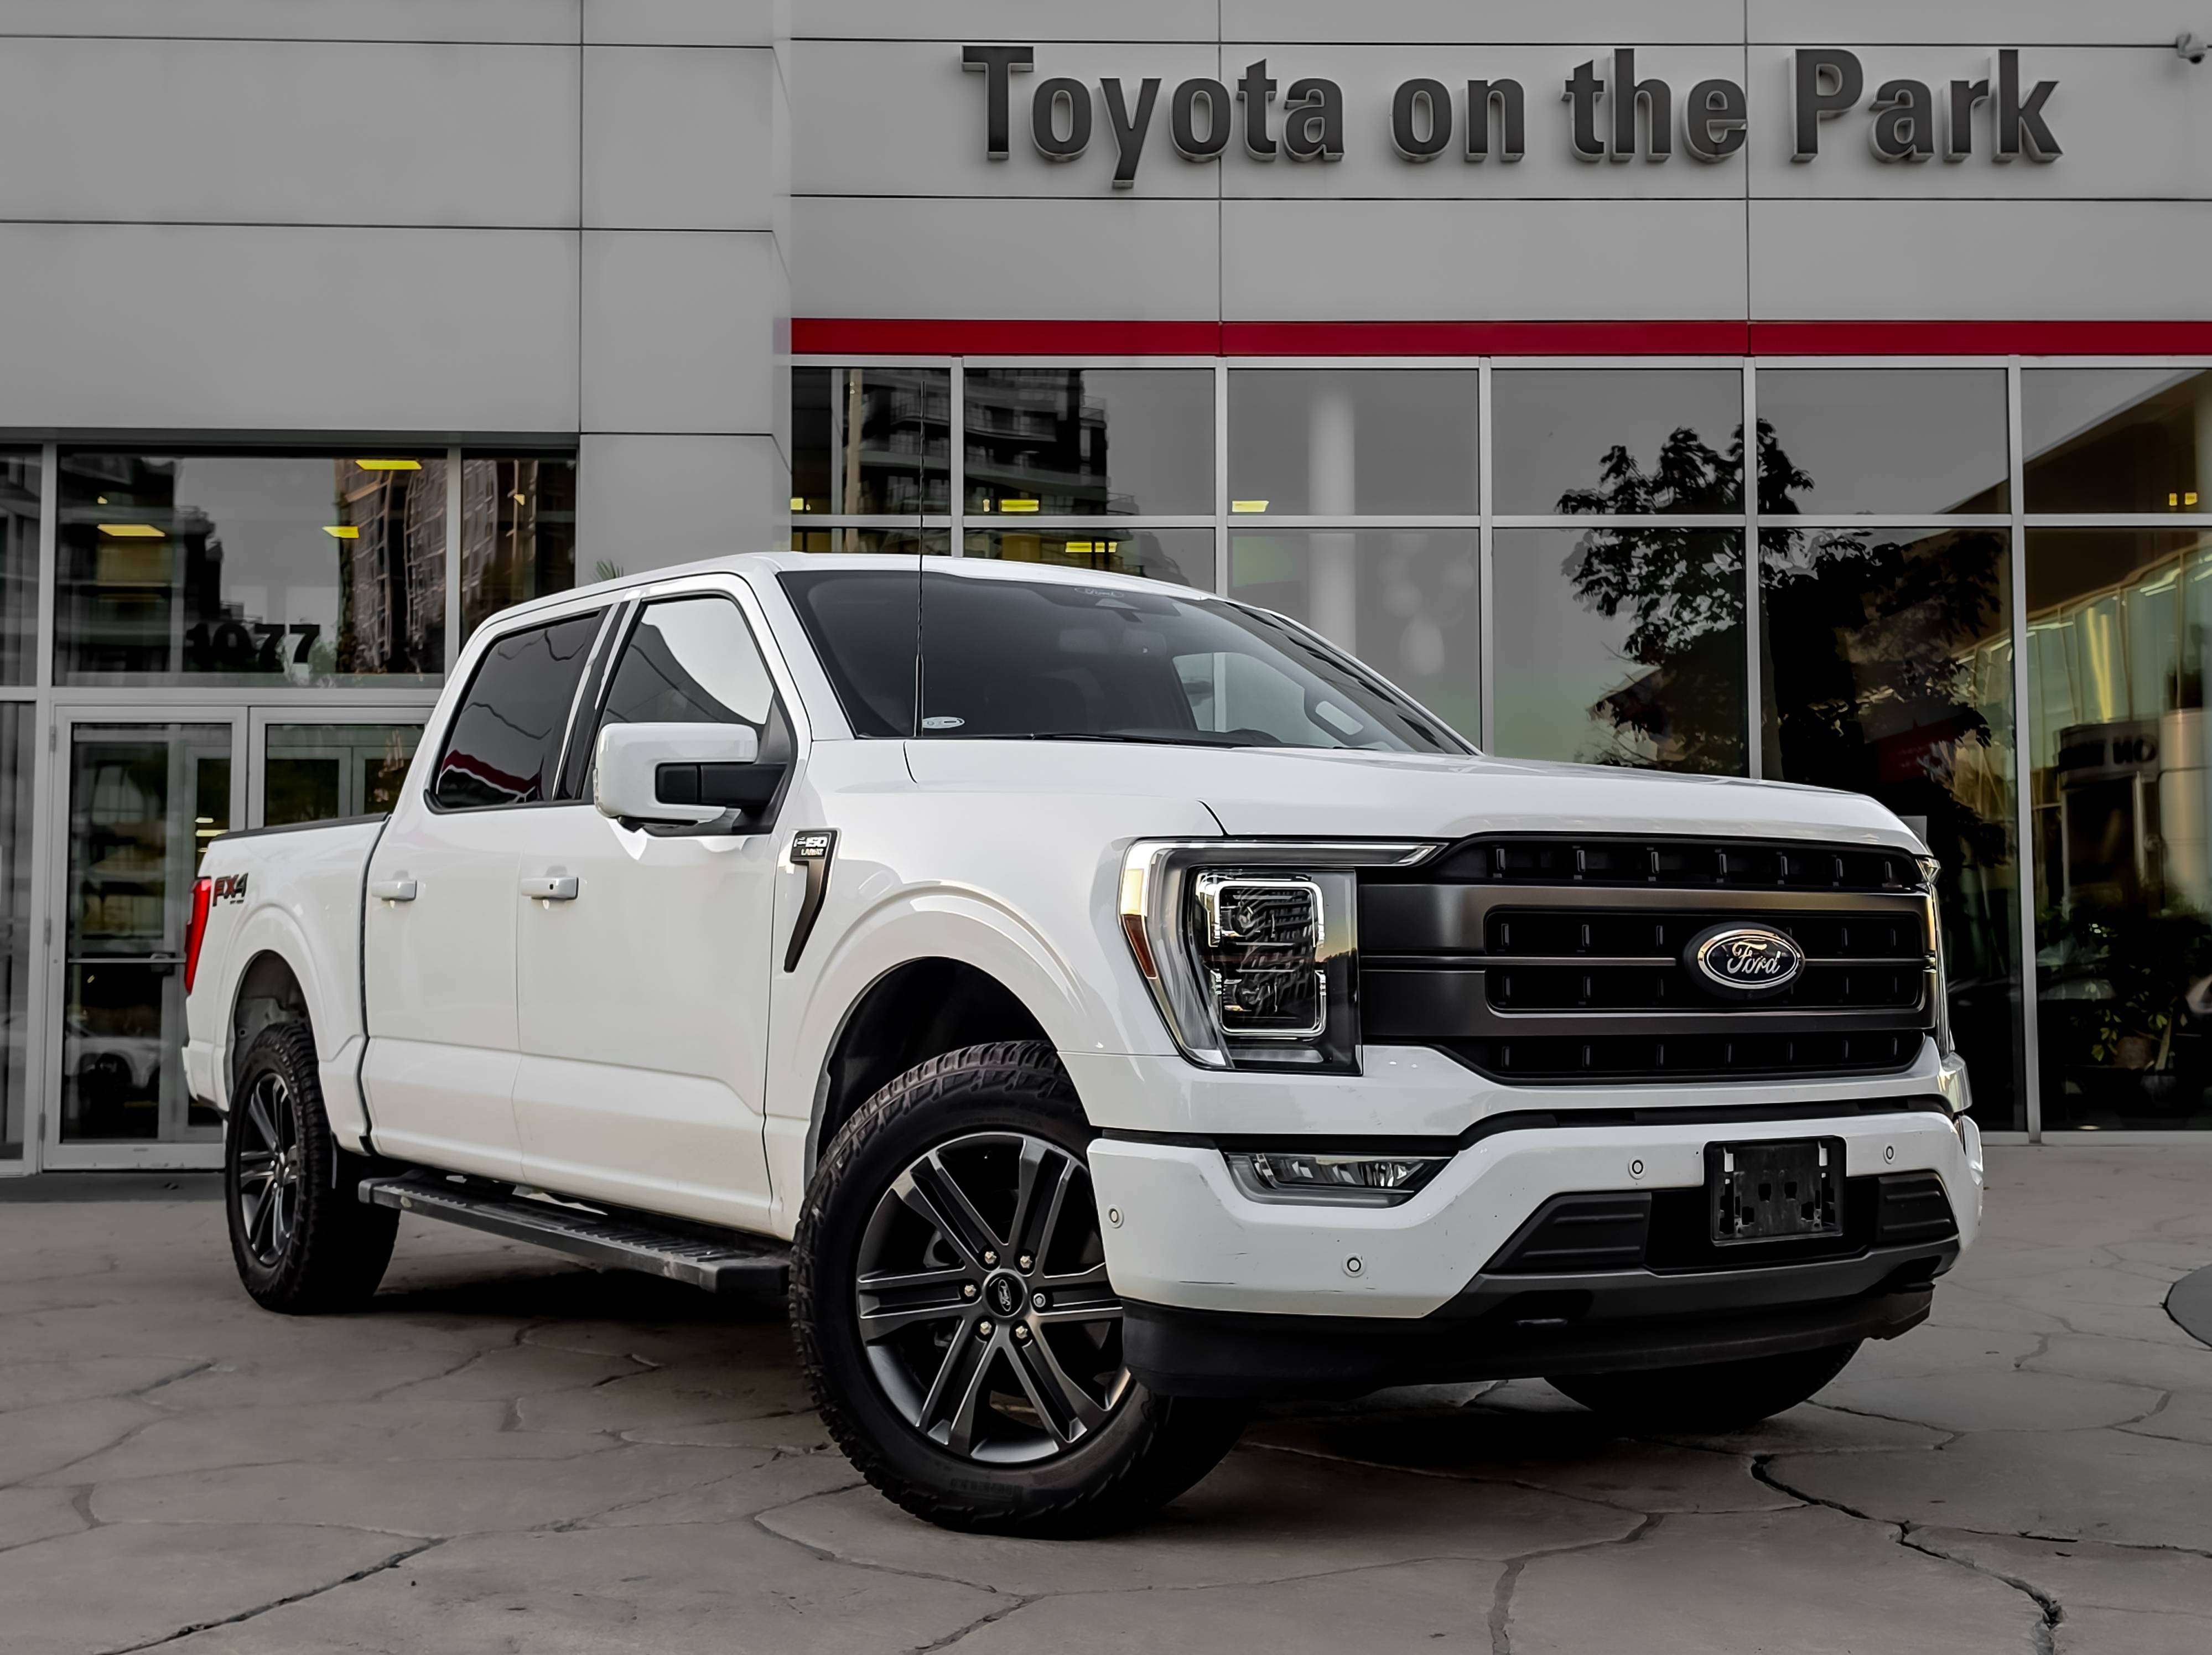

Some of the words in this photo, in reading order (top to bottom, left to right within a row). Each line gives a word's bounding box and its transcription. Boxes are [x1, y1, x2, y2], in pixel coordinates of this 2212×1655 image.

[960, 45, 1344, 189] Toyota
[1390, 78, 1525, 162] on
[1560, 48, 1748, 163] the
[1789, 49, 2064, 163] Park
[186, 623, 320, 665] 1077
[212, 872, 249, 907] FX4
[1727, 941, 1782, 974] Ford
